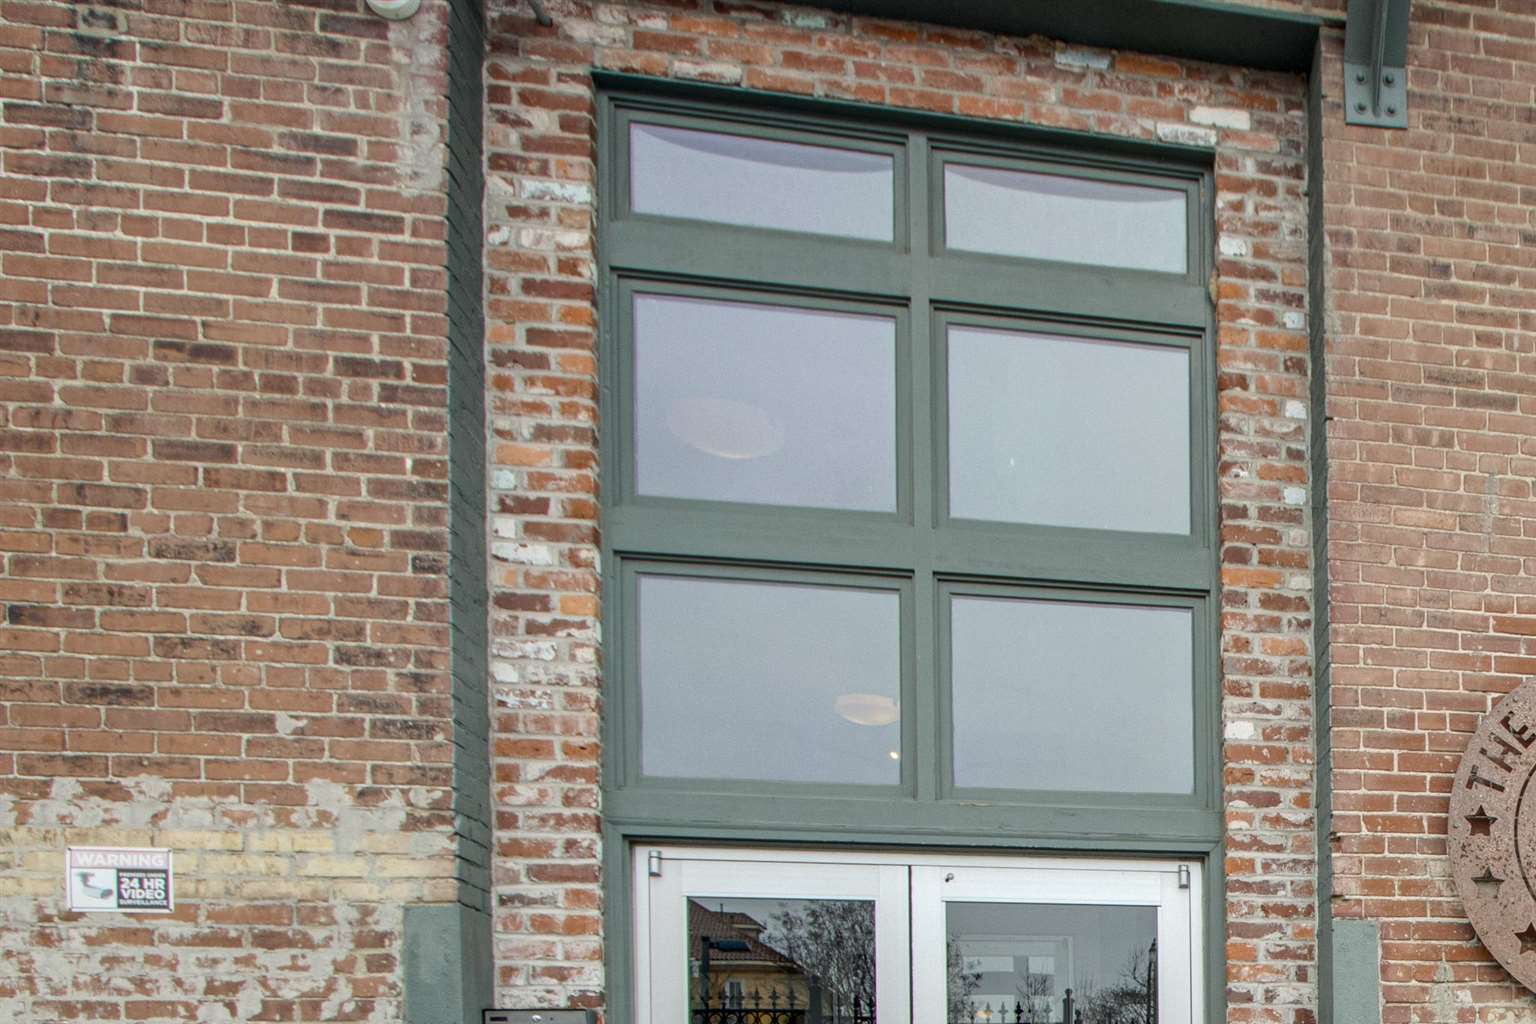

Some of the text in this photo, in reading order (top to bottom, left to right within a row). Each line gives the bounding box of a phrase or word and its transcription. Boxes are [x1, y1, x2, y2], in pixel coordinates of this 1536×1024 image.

[77, 854, 164, 866] WARNING
[120, 878, 166, 890] 24 HR
[120, 889, 166, 900] VIDEO
